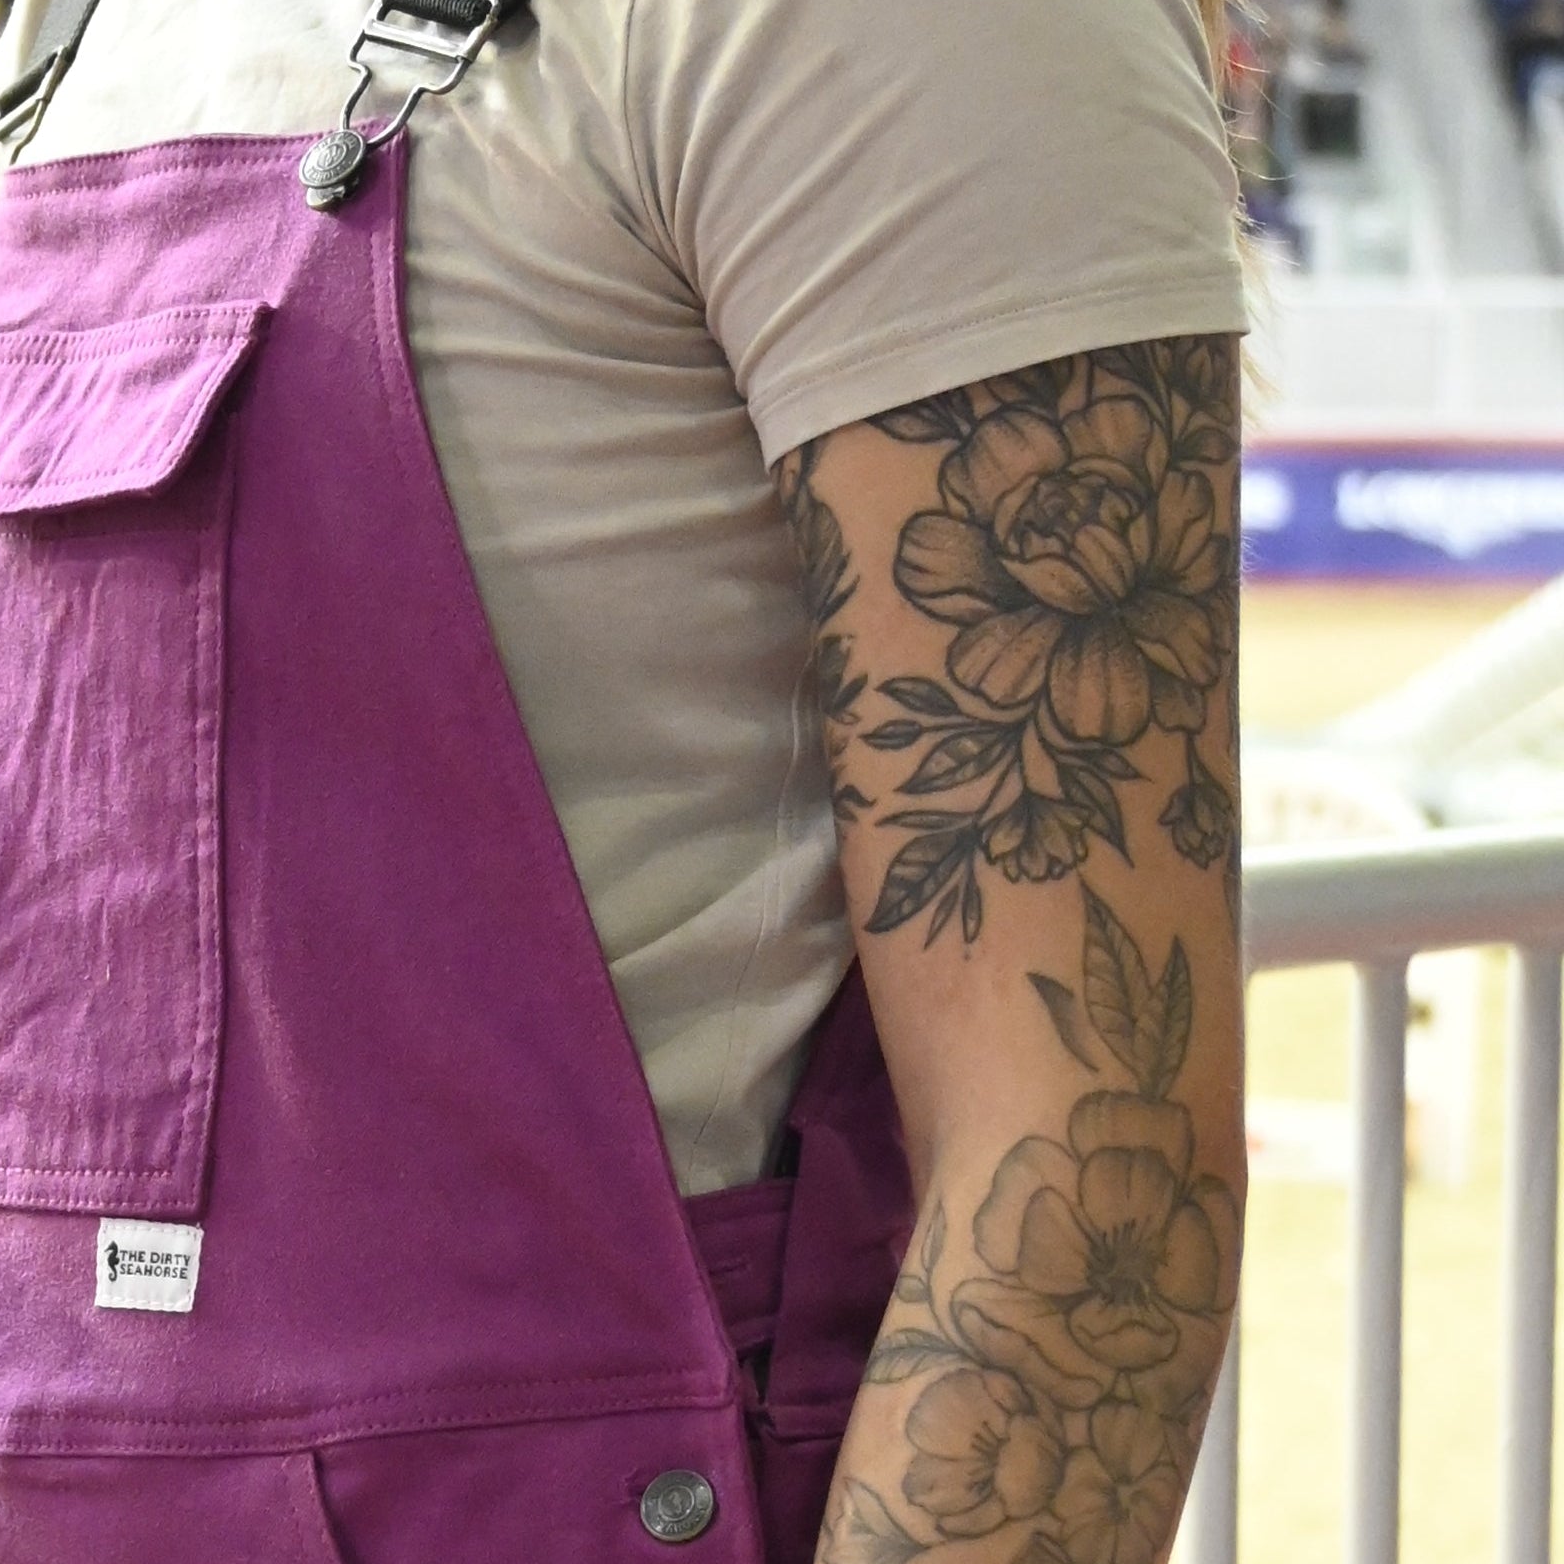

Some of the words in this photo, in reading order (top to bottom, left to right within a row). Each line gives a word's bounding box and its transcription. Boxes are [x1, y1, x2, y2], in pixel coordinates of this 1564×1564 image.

[119, 1250, 146, 1264] THE
[149, 1251, 192, 1267] DIRTY
[119, 1263, 188, 1280] SEAHORSE
